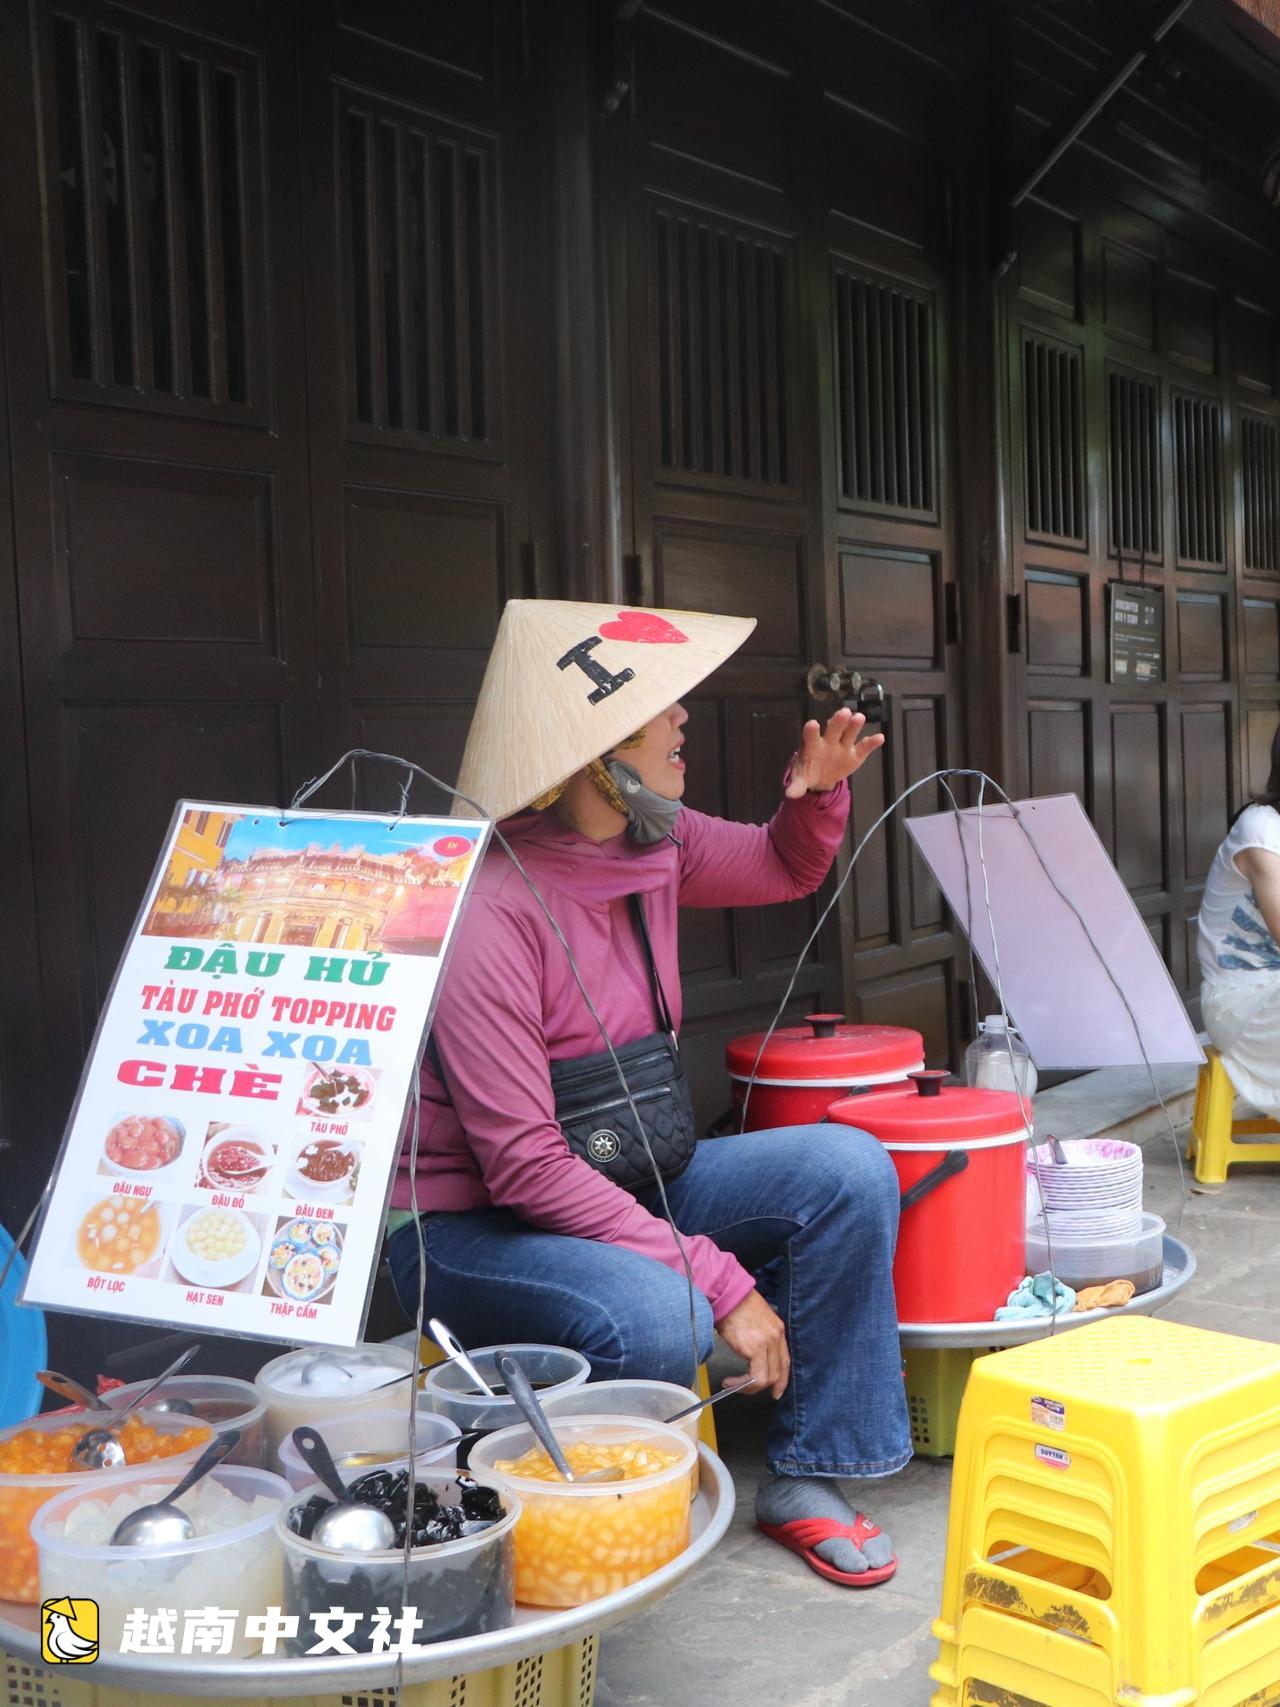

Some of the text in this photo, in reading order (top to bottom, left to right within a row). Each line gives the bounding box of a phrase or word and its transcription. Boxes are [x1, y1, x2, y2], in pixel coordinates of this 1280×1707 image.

[556, 635, 636, 706] I
[163, 942, 391, 986] ĐẬU HỦ
[141, 979, 397, 1032] TÀU PHỚ TOPPING
[136, 1019, 373, 1066] XOA XOA
[117, 1059, 283, 1100] CHÈ
[205, 1295, 225, 1307] SEN
